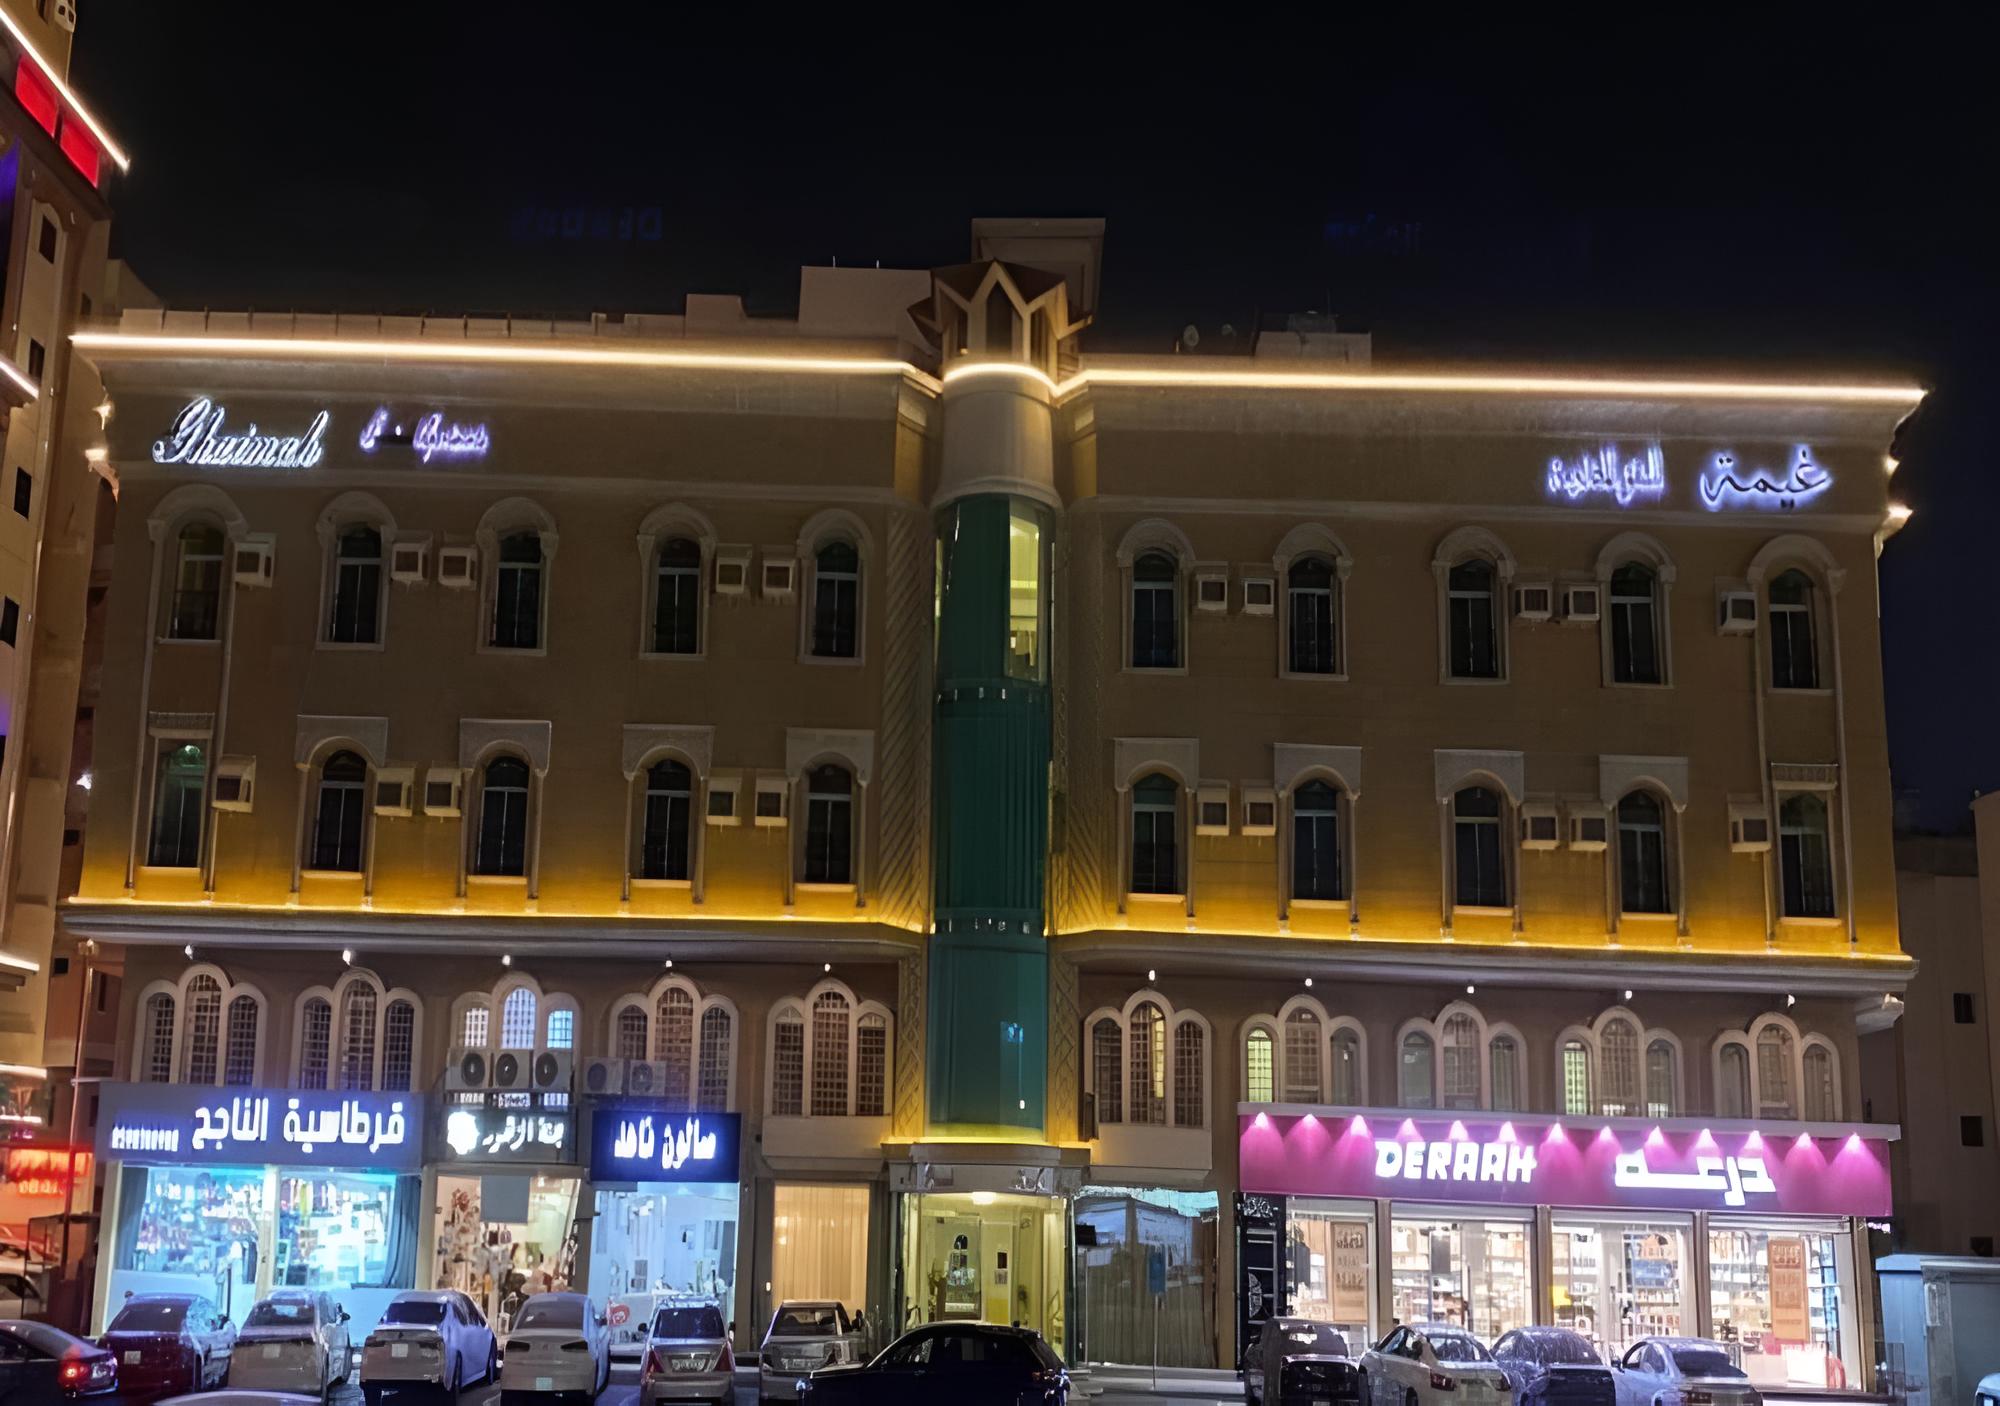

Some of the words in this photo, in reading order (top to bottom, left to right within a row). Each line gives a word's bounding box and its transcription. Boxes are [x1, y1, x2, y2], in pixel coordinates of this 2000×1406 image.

[191, 1097, 270, 1151] الناجح
[282, 1098, 406, 1153] قرطاسية
[1375, 1140, 1537, 1183] DERAAH
